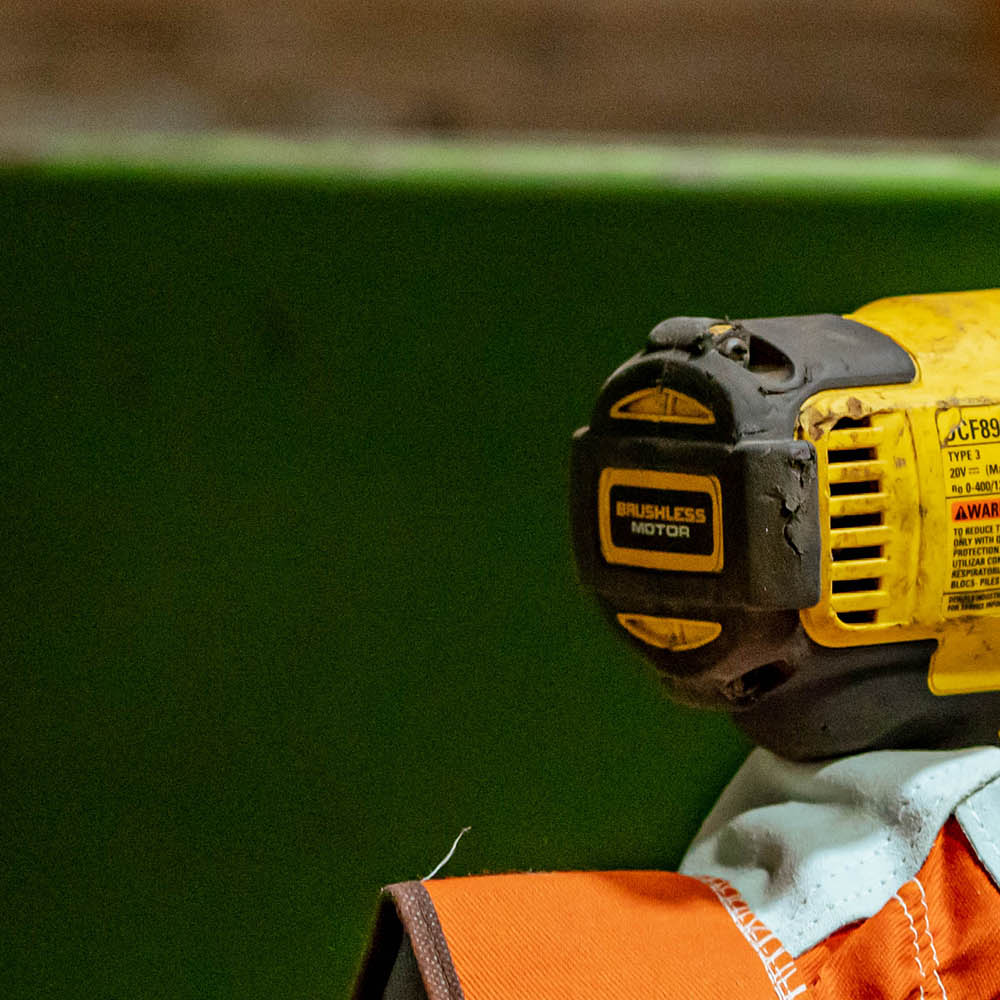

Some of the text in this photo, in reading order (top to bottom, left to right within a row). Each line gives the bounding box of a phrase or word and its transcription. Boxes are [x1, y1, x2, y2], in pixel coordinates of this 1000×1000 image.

[948, 449, 981, 462] TYPE 3
[949, 467, 966, 479] 20V
[615, 500, 706, 523] BRUSHLESS
[631, 521, 690, 538] MOTOR
[954, 528, 963, 536] TO
[965, 526, 993, 535] REDUCE
[954, 538, 971, 546] ONLY
[974, 536, 994, 544] WITH
[953, 558, 985, 568] UTILIZAR
